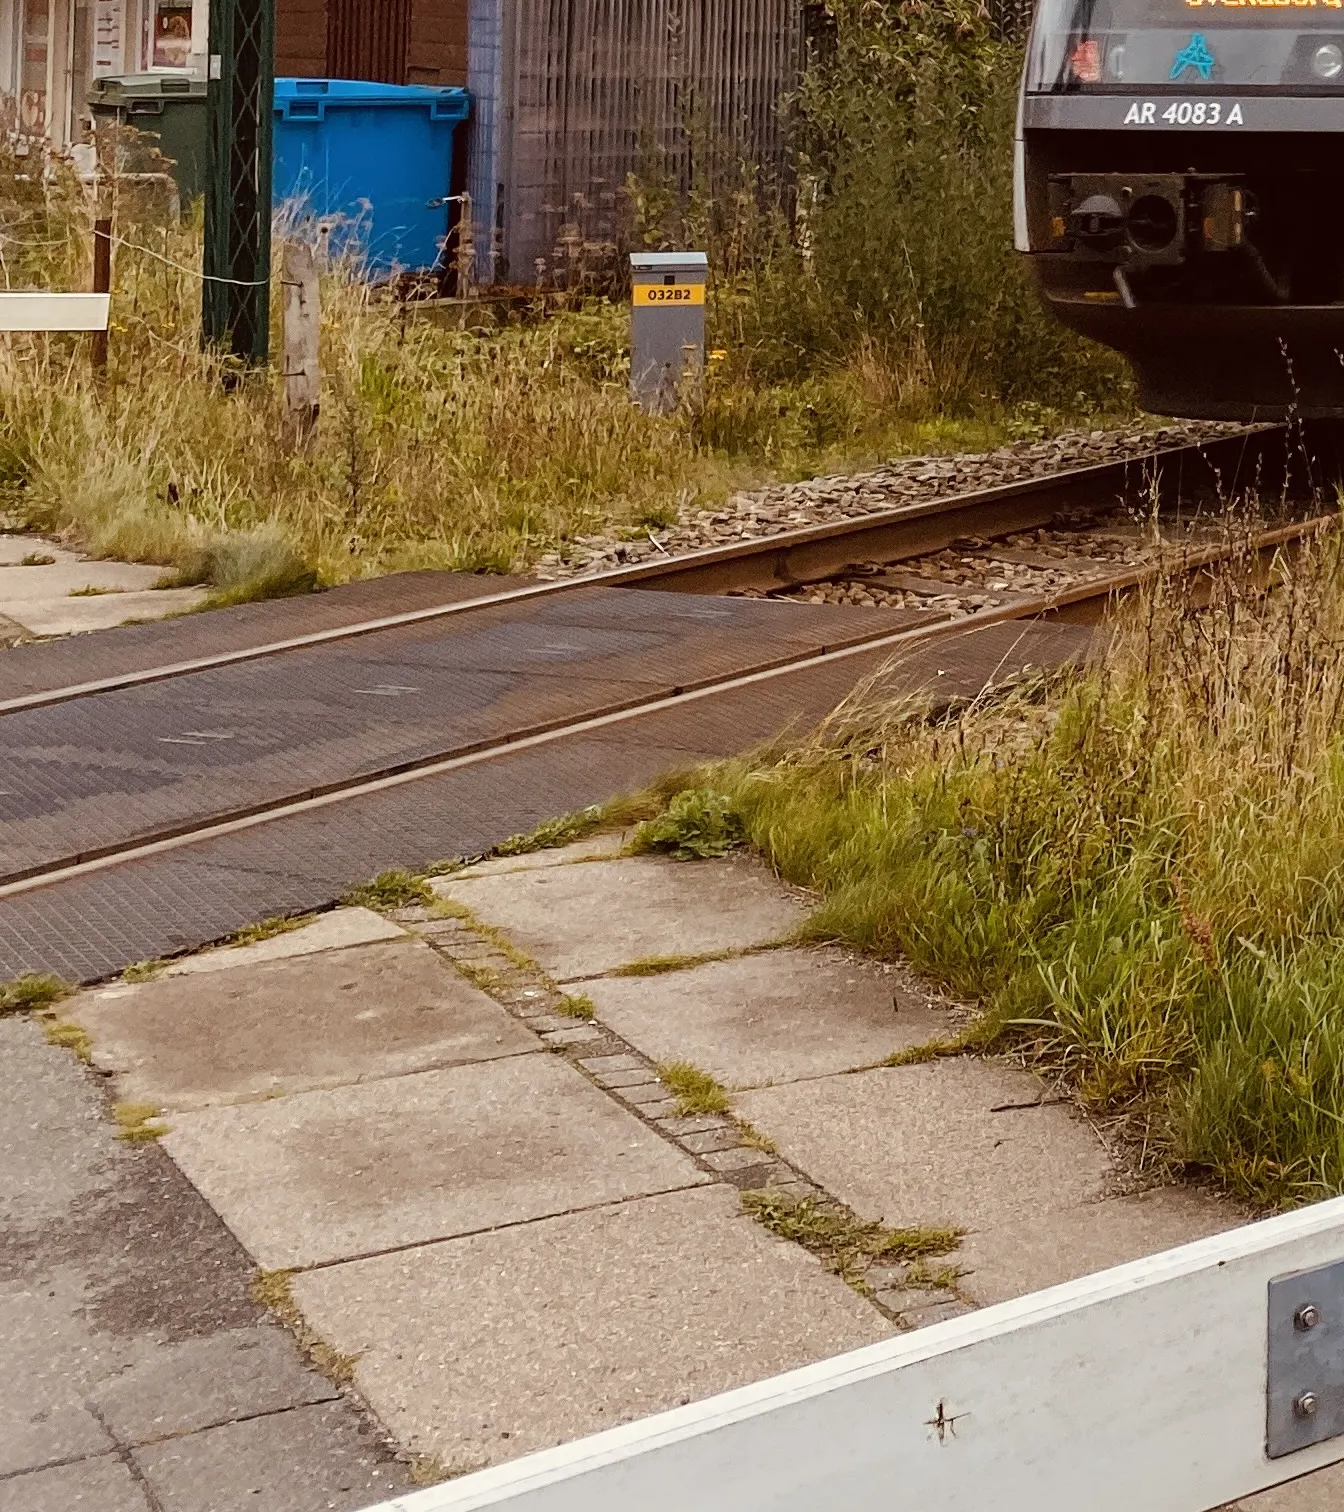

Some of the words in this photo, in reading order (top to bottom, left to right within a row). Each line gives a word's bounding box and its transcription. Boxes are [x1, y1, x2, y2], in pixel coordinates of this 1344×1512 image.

[1123, 102, 1157, 125] AR
[1161, 102, 1222, 125] 4083
[1224, 103, 1244, 126] A
